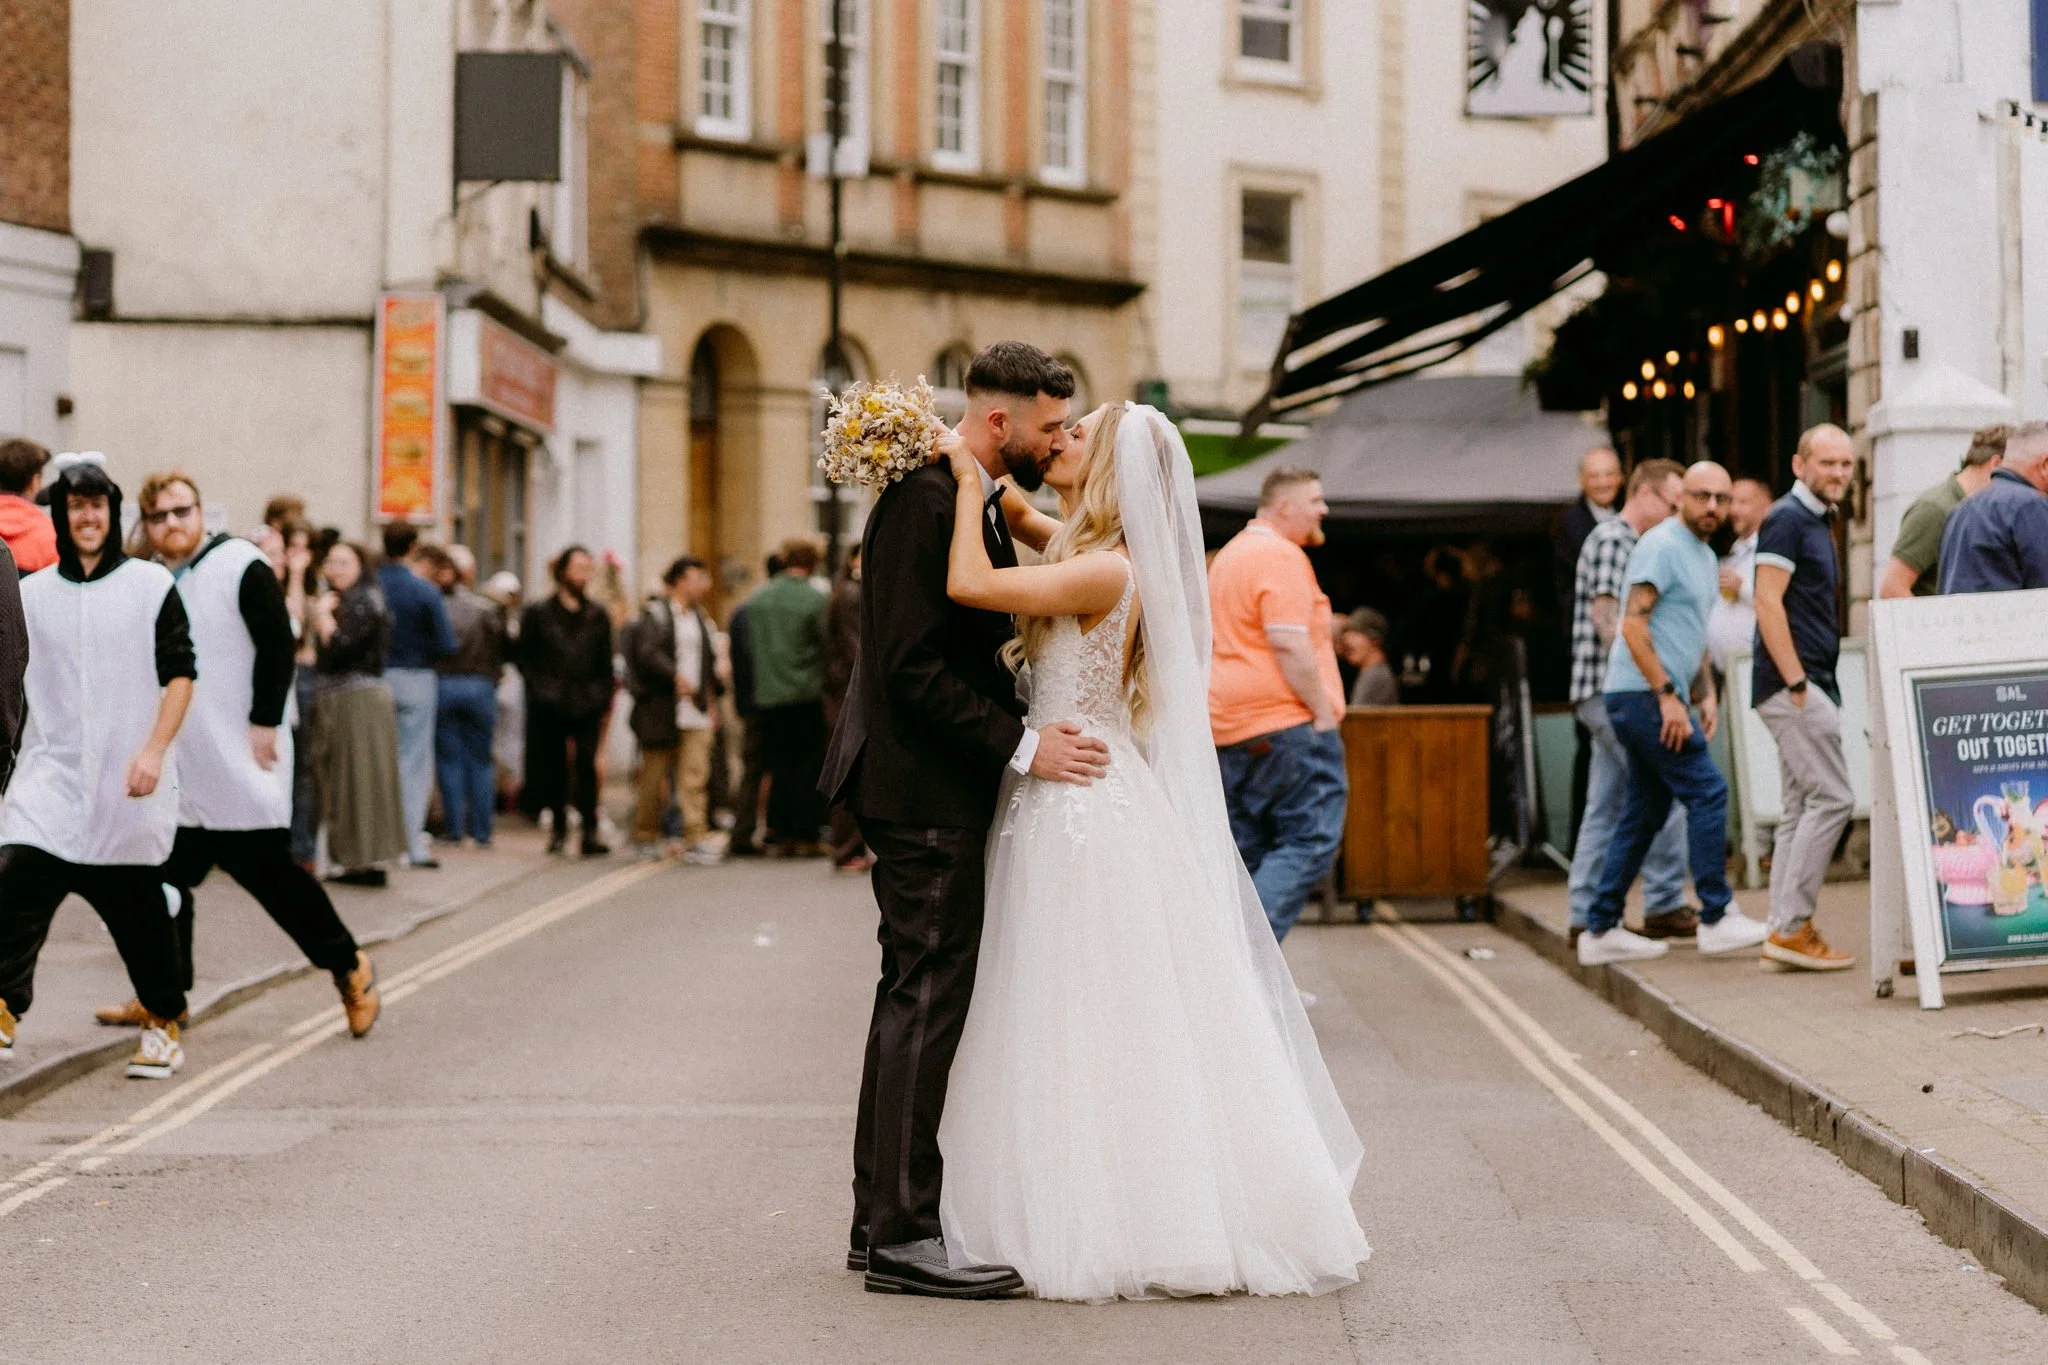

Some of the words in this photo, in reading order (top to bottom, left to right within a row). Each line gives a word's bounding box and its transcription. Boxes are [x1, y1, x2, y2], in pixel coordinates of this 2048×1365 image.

[1932, 714, 1977, 736] GET
[1980, 709, 2048, 733] TOGET
[1957, 737, 1990, 761] OUT
